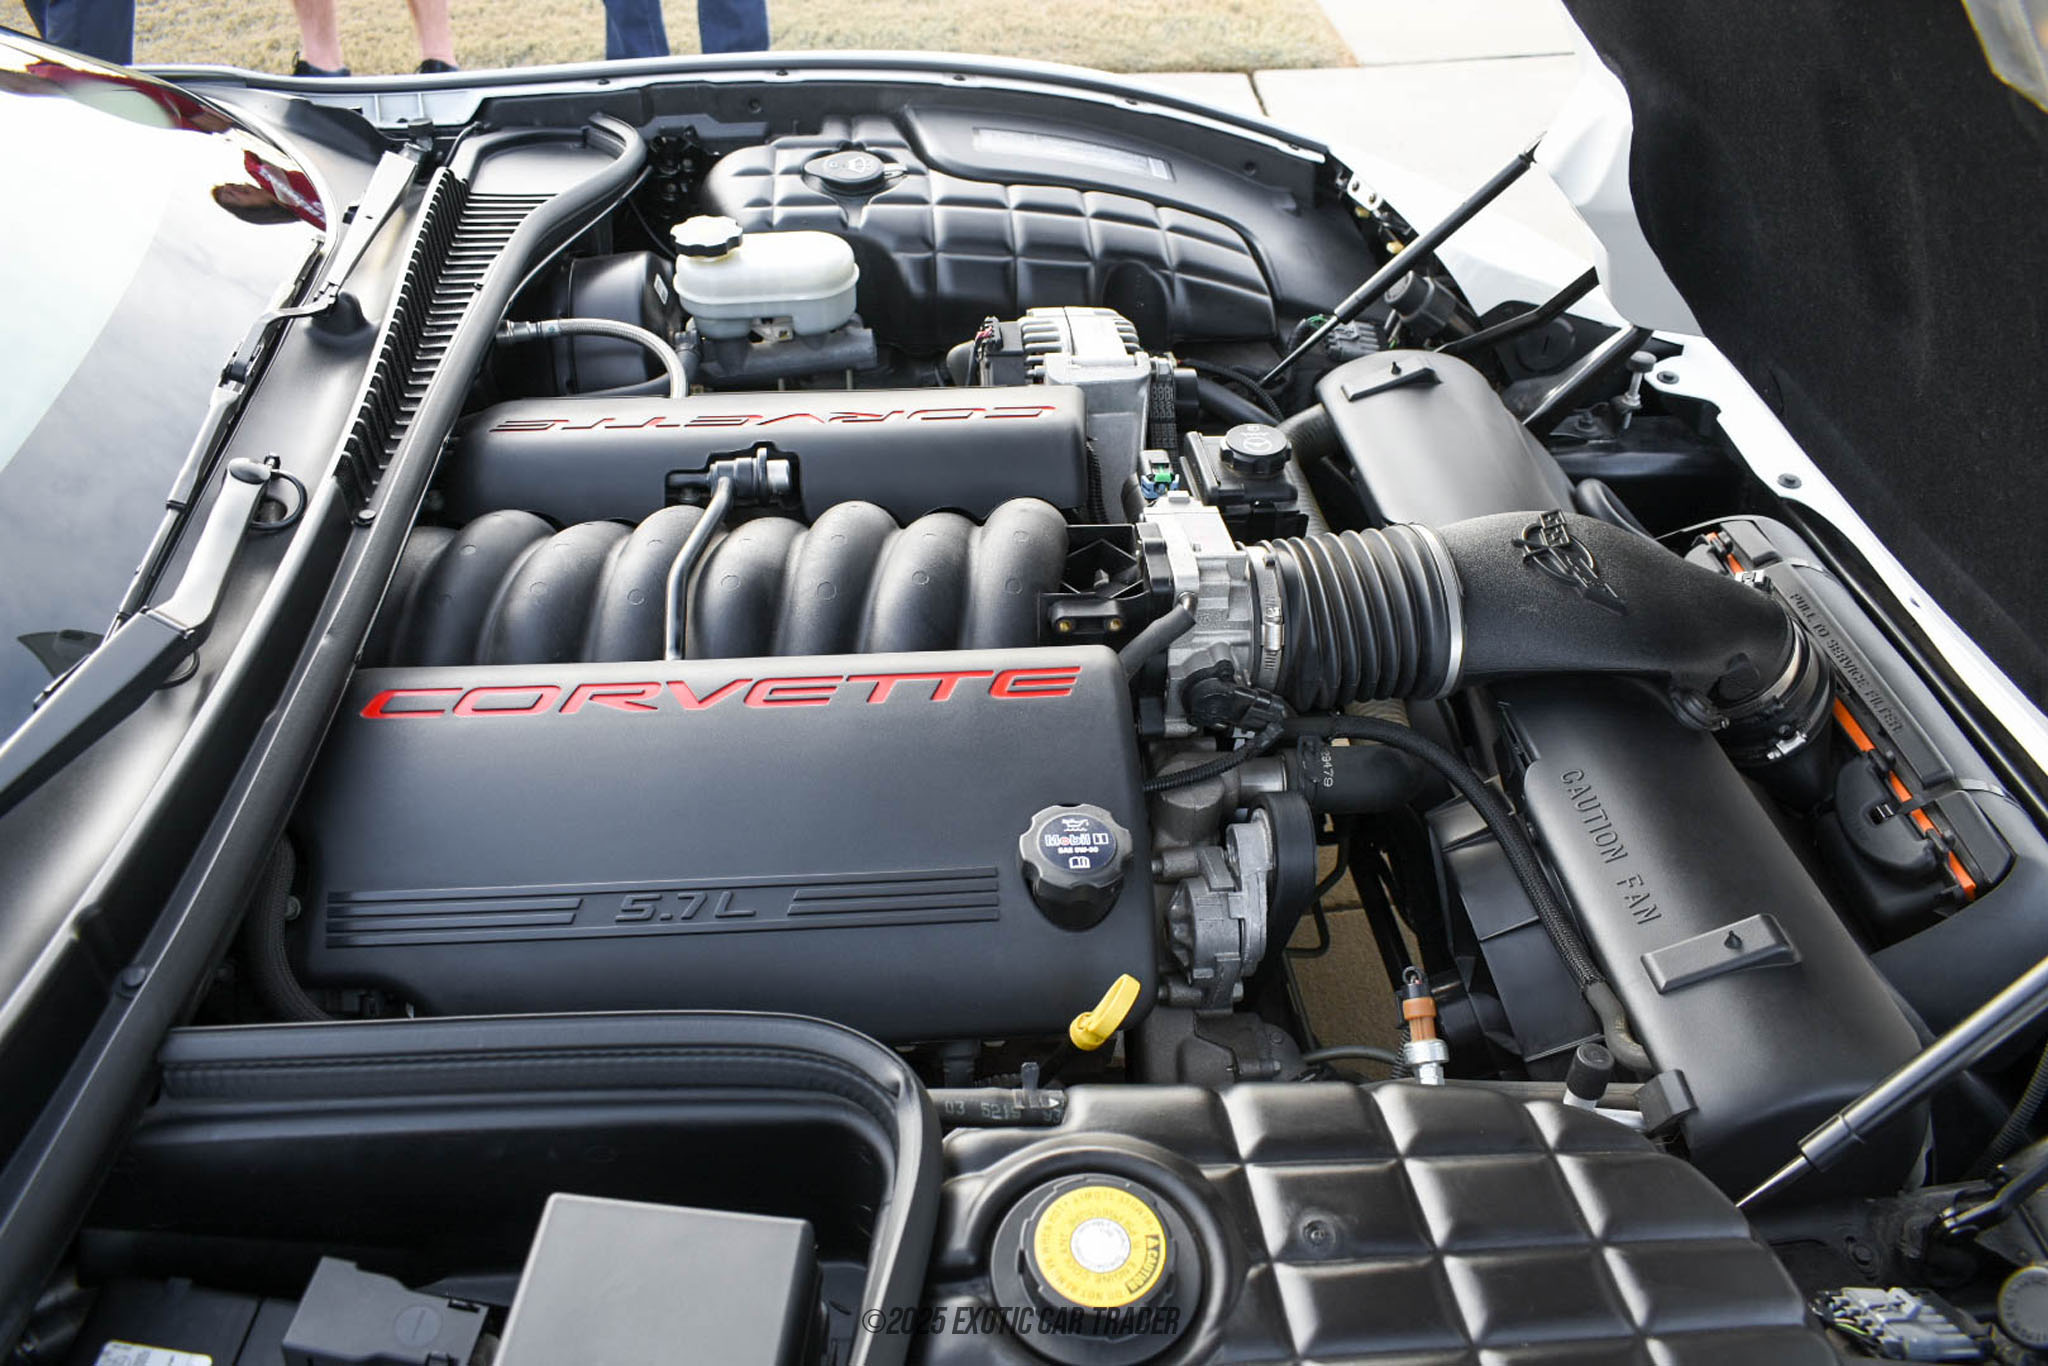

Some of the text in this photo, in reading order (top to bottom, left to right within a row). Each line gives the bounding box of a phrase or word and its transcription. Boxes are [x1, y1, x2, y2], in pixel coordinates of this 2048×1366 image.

[489, 405, 1056, 432] CORVETTE
[1790, 593, 1904, 732] PULL TO SERVICE FILTER
[360, 664, 1083, 720] CORVETTE
[1045, 834, 1091, 847] Mobil
[1560, 768, 1663, 925] CAUTION FAN
[615, 890, 757, 923] 5.7L
[1128, 1248, 1161, 1293] CAUTION
